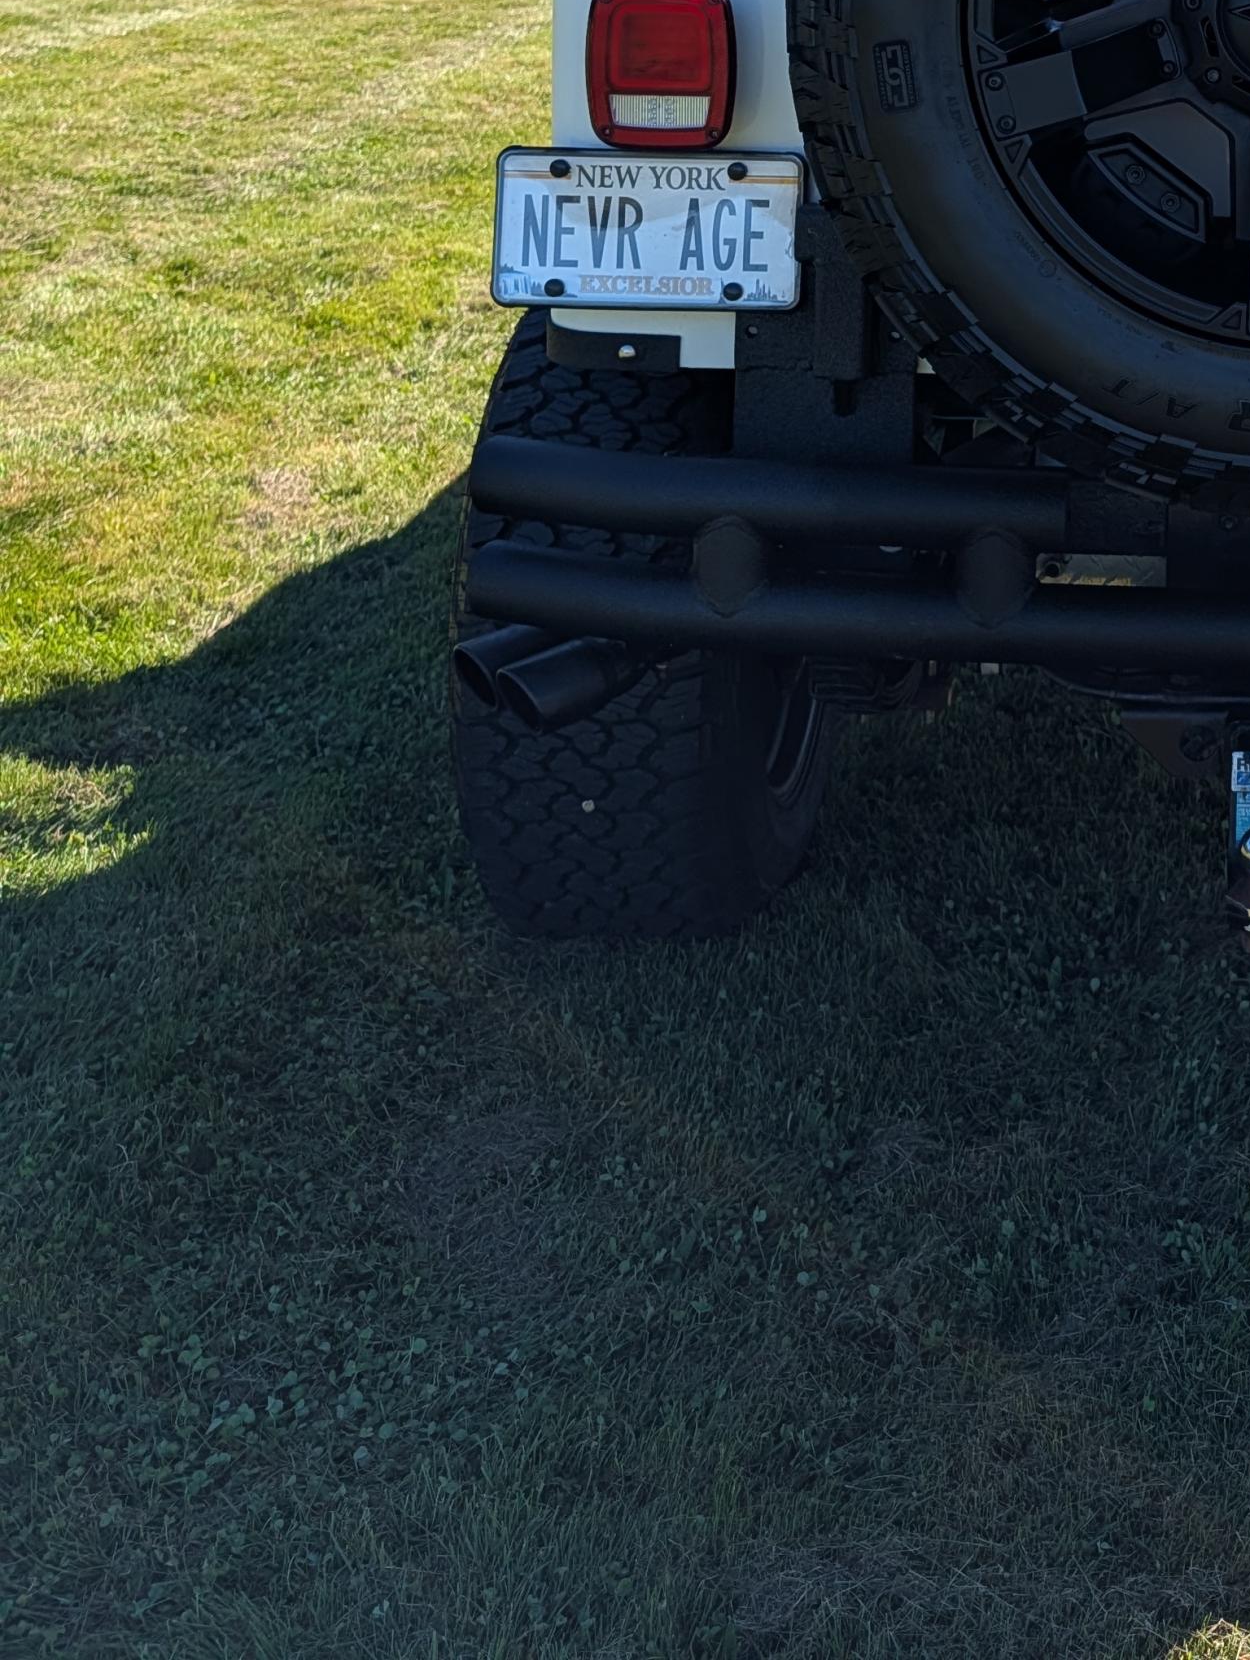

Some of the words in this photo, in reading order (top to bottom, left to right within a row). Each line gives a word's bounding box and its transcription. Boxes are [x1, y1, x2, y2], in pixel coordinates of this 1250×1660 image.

[575, 163, 643, 189] NEW
[648, 166, 726, 191] YORK
[521, 193, 643, 270] NEVR
[679, 197, 770, 272] AGE
[578, 275, 714, 296] EXCELSIOR
[1101, 376, 1199, 419] A/T
